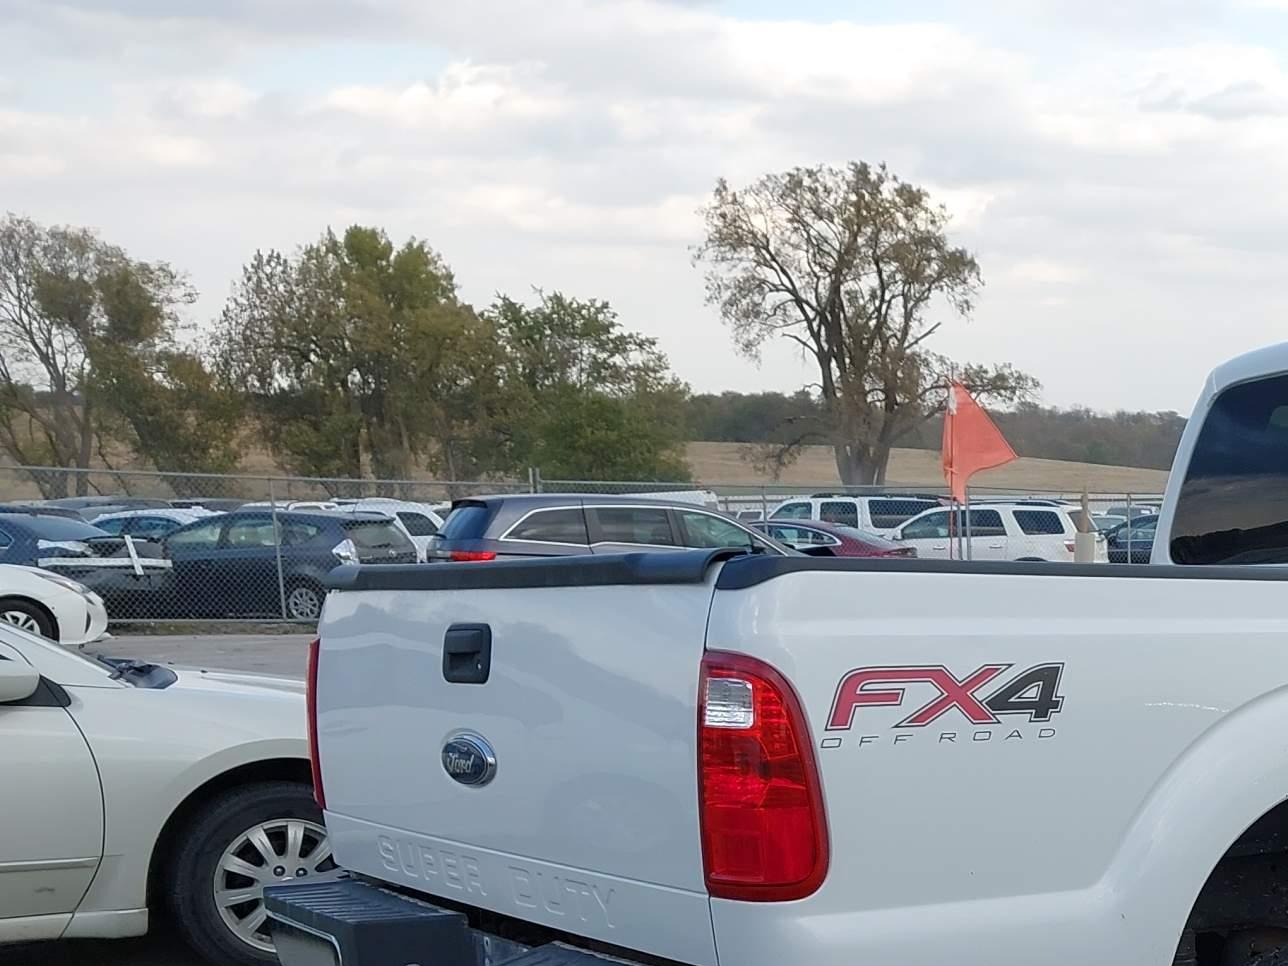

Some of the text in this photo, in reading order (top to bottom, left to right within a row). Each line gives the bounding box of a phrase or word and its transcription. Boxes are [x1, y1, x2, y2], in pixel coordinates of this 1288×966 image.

[825, 662, 1065, 731] FX4
[446, 743, 475, 774] Ford
[820, 728, 1057, 749] OFF ROAD
[375, 834, 617, 929] SUPER DUTY
